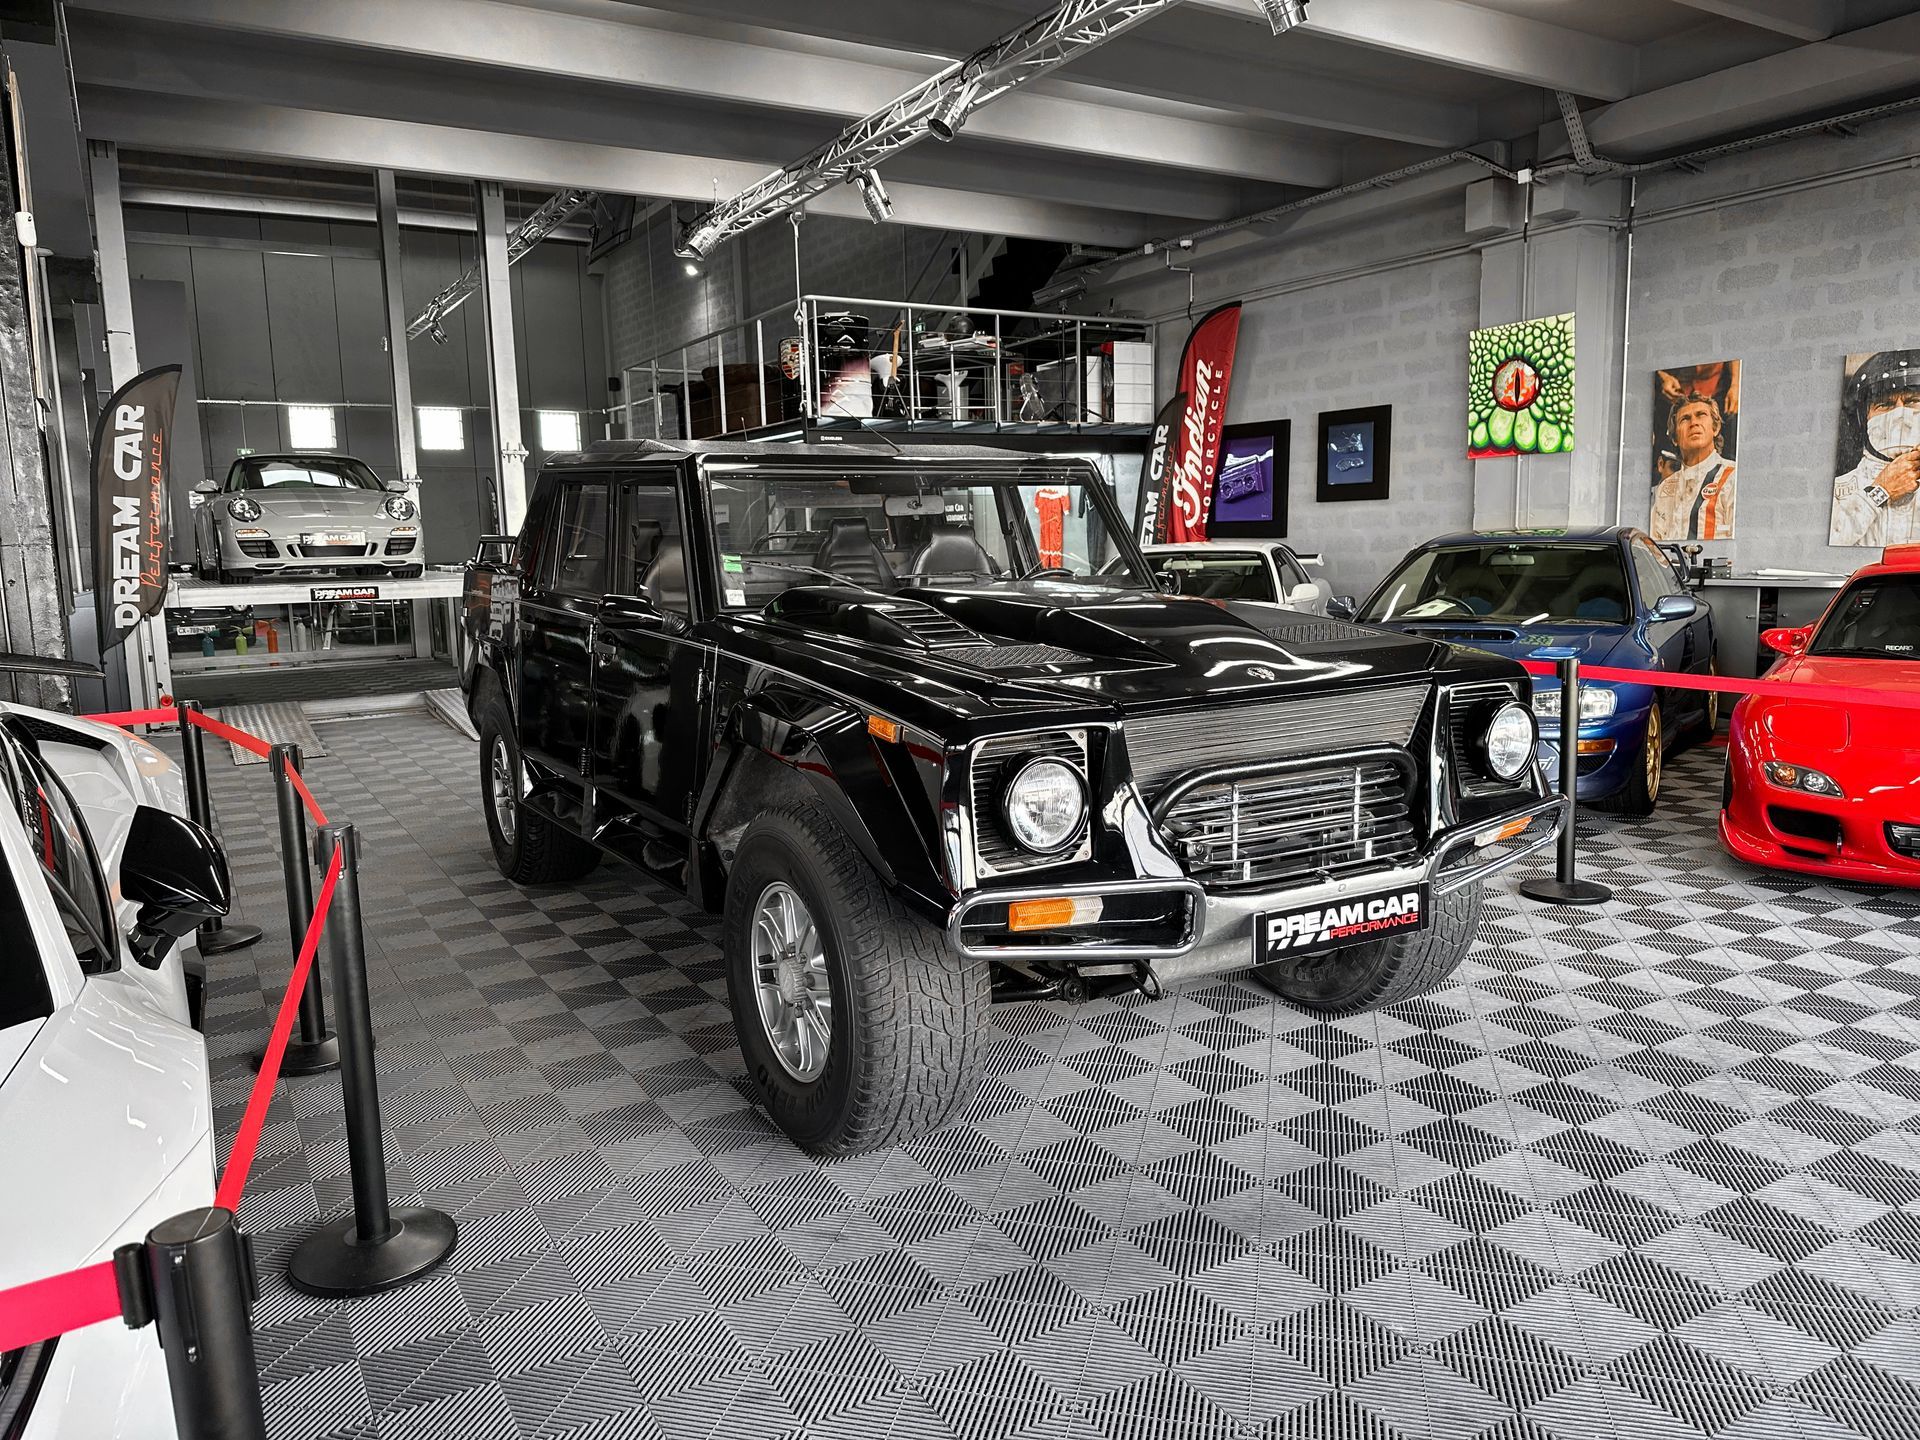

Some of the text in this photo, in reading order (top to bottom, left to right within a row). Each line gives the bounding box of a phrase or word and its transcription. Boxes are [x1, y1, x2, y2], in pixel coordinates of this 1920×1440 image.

[1140, 424, 1169, 546] EAM CAR
[1156, 440, 1176, 545] rformance
[1172, 359, 1212, 528] Indian
[1202, 369, 1223, 524] MOTORCYCLE
[112, 404, 145, 629] DREAM CAR
[140, 428, 164, 588] Performance
[302, 534, 339, 542] DAM
[315, 589, 352, 597] DREAM
[1268, 892, 1419, 941] DREAM CAR
[1330, 912, 1419, 939] PERFORMANCE
